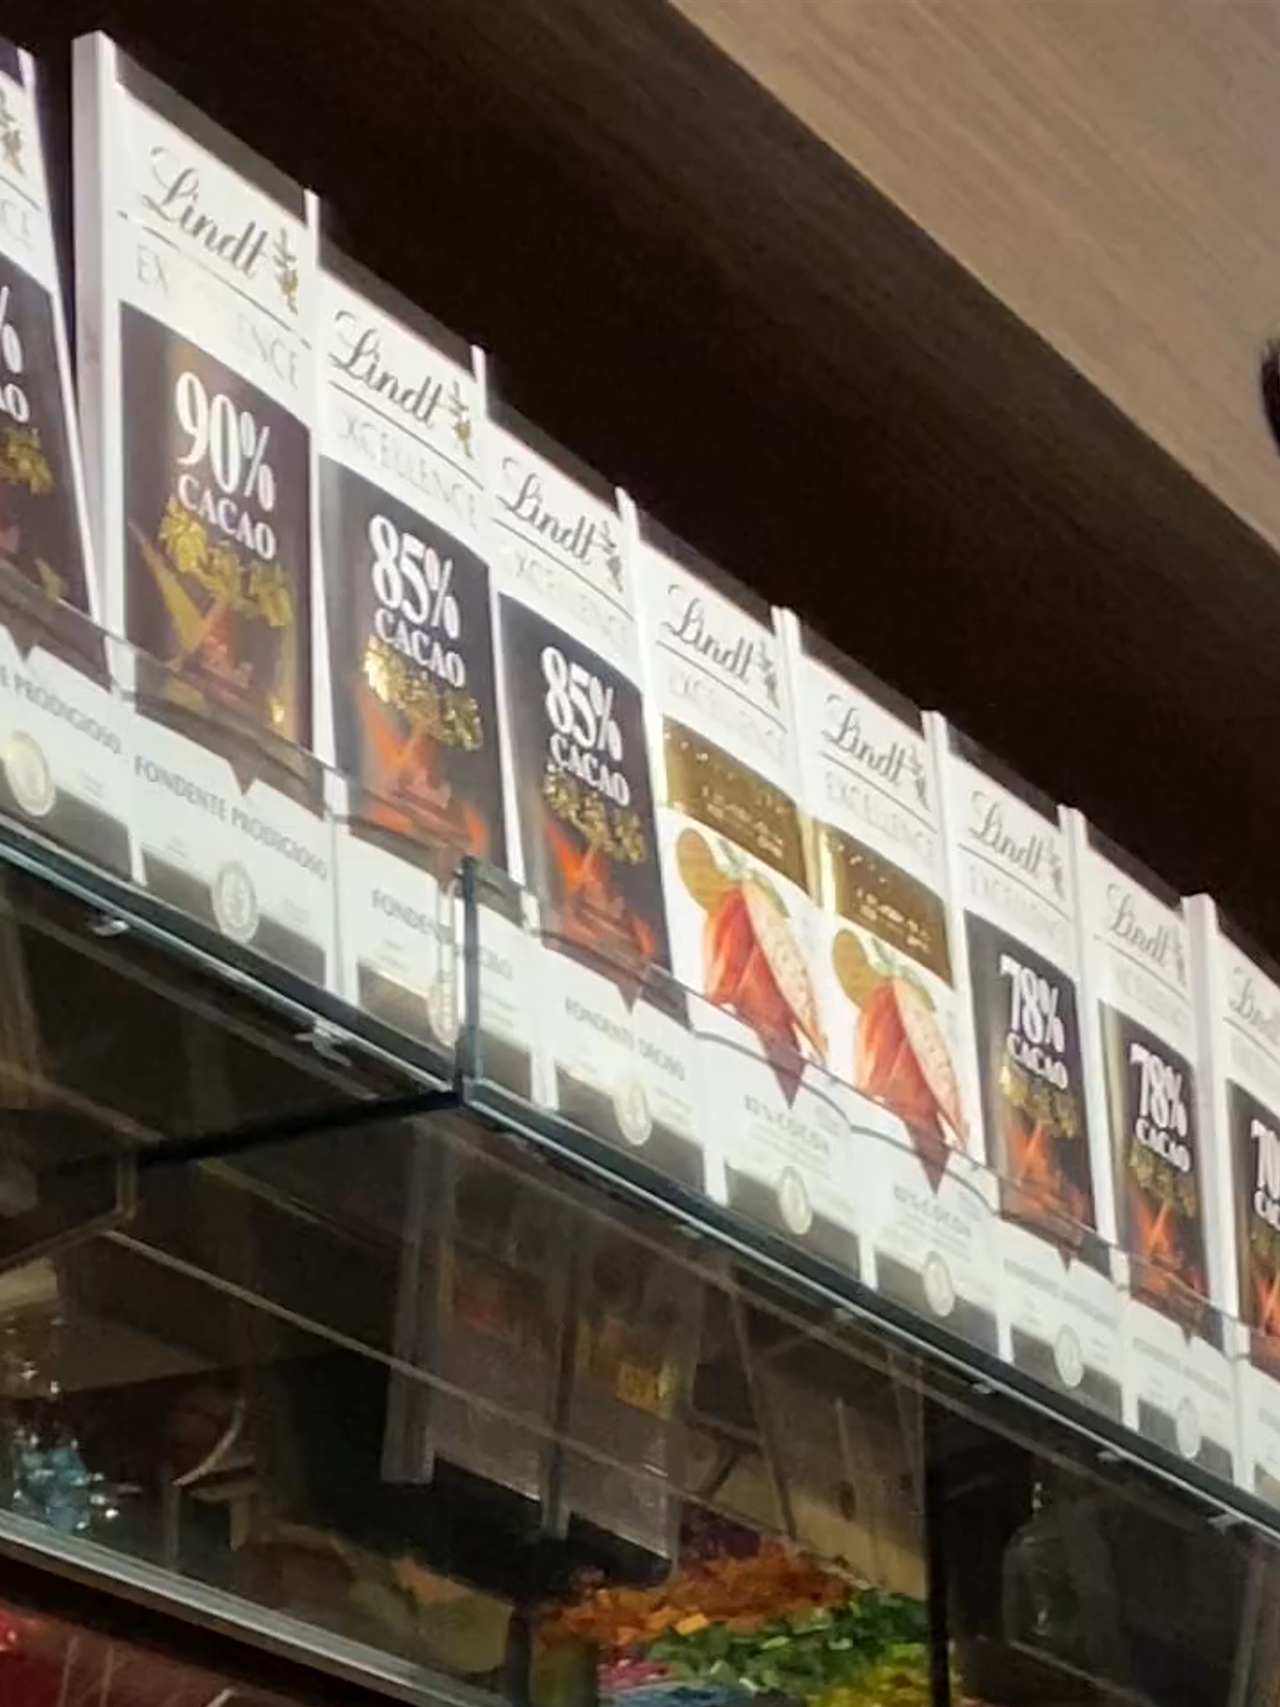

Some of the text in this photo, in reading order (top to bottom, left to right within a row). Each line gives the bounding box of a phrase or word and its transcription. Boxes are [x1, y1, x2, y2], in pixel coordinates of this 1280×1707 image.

[142, 146, 267, 276] Lindt
[324, 311, 443, 420] Lindt
[175, 373, 277, 511] 90%
[178, 473, 277, 560] CACAO
[495, 456, 598, 562] Lindt
[368, 514, 460, 639] 85%
[373, 608, 467, 689] CACAO
[541, 645, 624, 763] 85%
[546, 729, 630, 808] CACAO
[1001, 955, 1065, 1053] 78%
